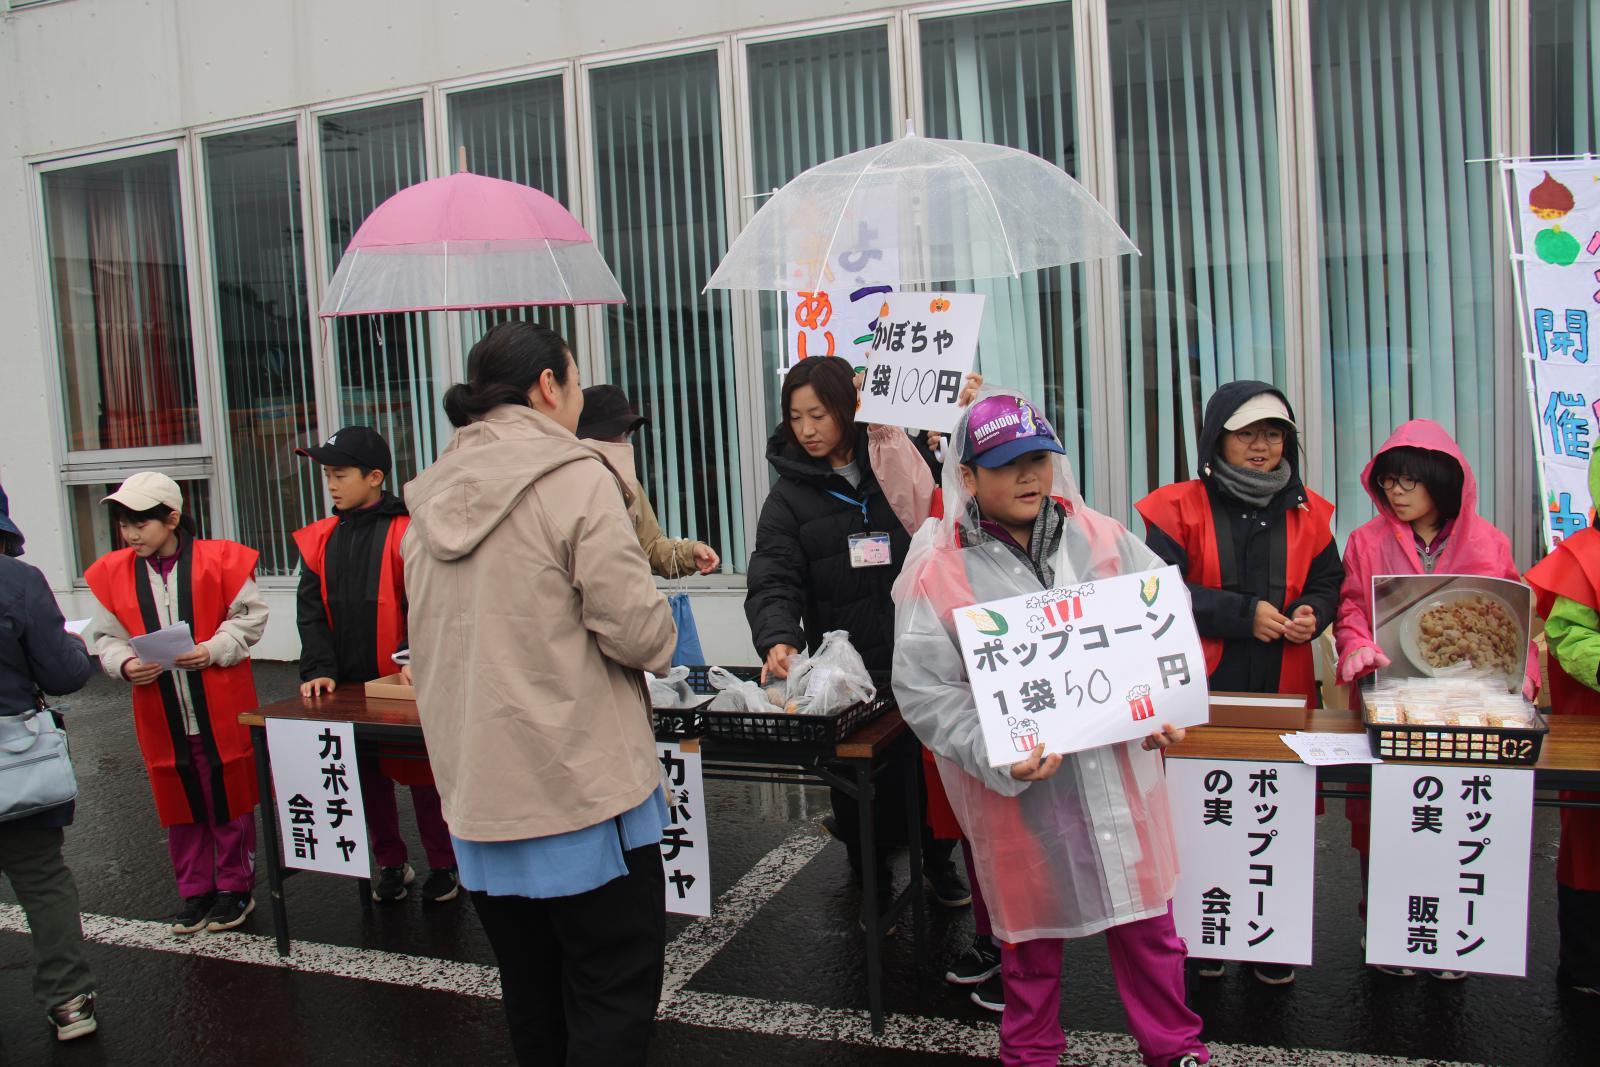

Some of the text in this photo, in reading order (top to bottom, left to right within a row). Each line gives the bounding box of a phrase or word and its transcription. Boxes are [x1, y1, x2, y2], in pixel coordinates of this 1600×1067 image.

[872, 320, 954, 355] かぼちゃ
[973, 413, 1021, 441] MIRAIDON
[1534, 308, 1590, 539] 開催中
[973, 611, 1176, 672] ポップコーン
[318, 728, 357, 862] カボチャ
[1502, 738, 1533, 759] 02
[288, 793, 319, 861] 会計
[1201, 769, 1233, 946] の実 会計
[1247, 768, 1279, 948] ポップコーン
[1406, 775, 1443, 955] の実 販売
[1455, 774, 1491, 957] ポップコーン
